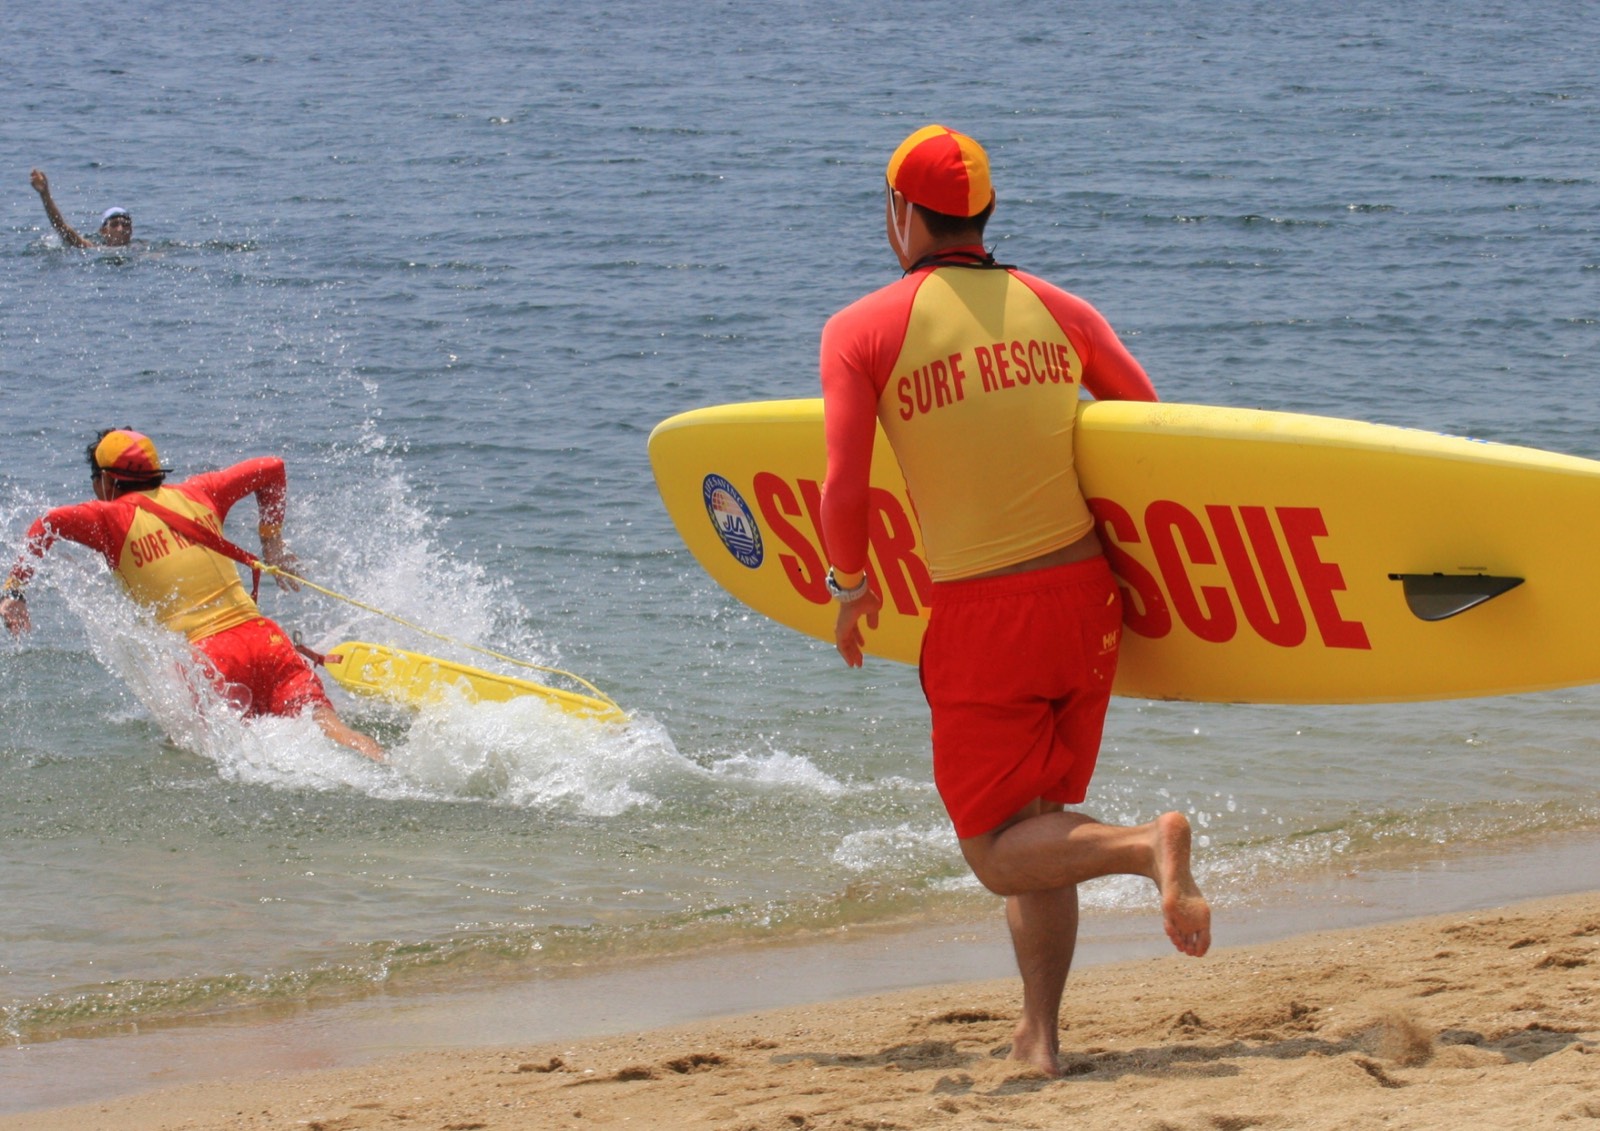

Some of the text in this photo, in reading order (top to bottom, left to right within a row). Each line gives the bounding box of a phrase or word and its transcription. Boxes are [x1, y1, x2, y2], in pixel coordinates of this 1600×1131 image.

[897, 339, 1075, 421] SURF RESCUE
[130, 529, 170, 568] SURF
[753, 471, 1373, 651] SR SCUE
